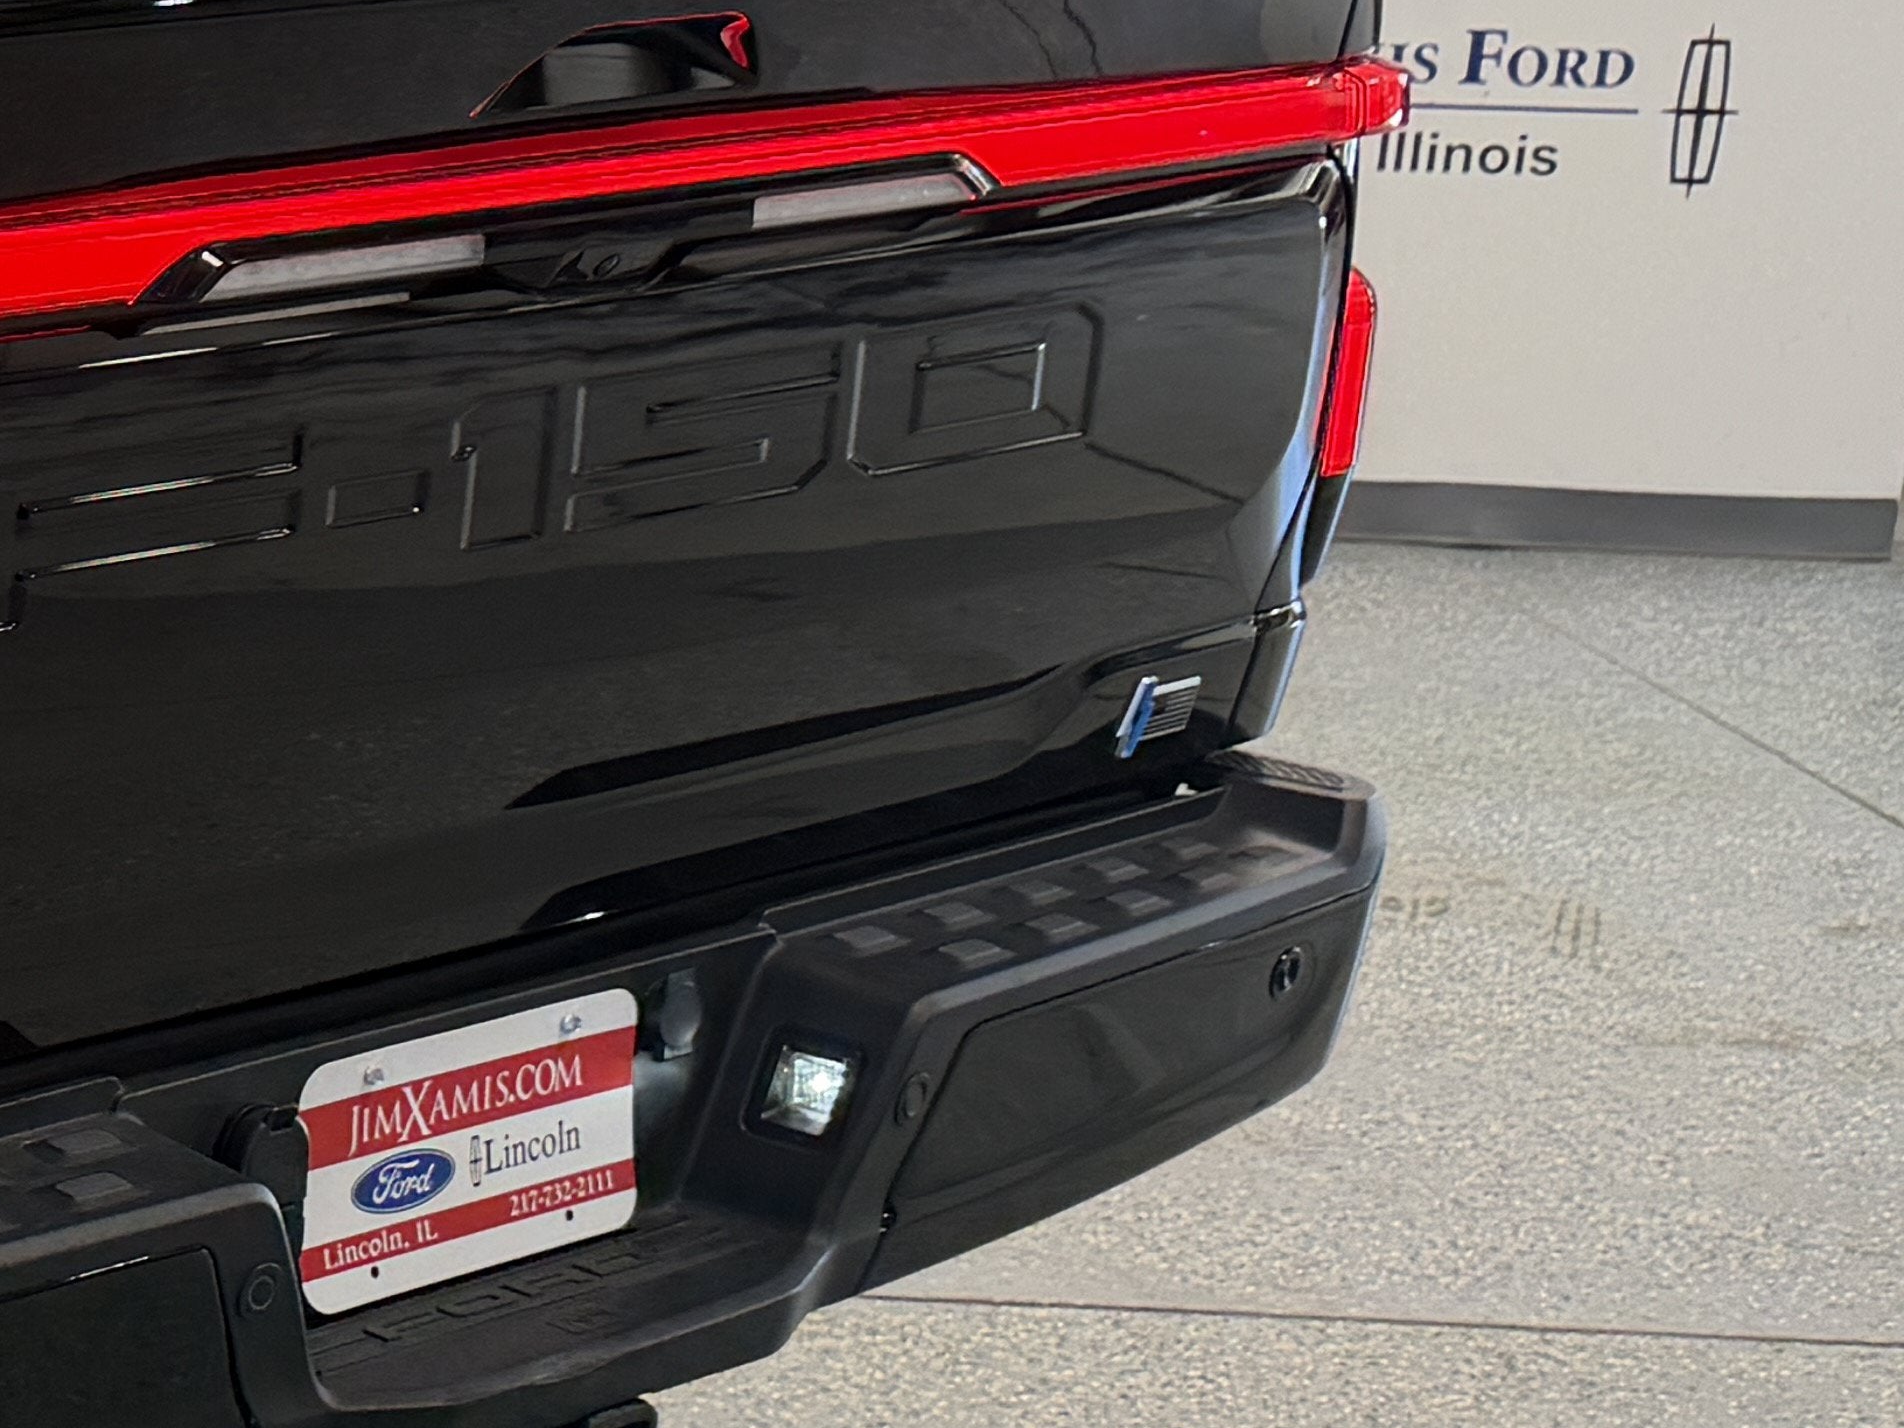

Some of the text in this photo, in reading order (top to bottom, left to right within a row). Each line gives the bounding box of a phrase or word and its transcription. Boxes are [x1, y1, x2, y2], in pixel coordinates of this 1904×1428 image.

[1458, 28, 1635, 89] FORD
[1377, 130, 1559, 176] Illinois
[347, 1054, 584, 1157] JIMXAMIS.COM
[483, 1119, 581, 1176] Lincoln
[372, 1159, 434, 1204] Ford
[508, 1169, 614, 1217] 217-732-2111
[416, 1220, 438, 1244] IL
